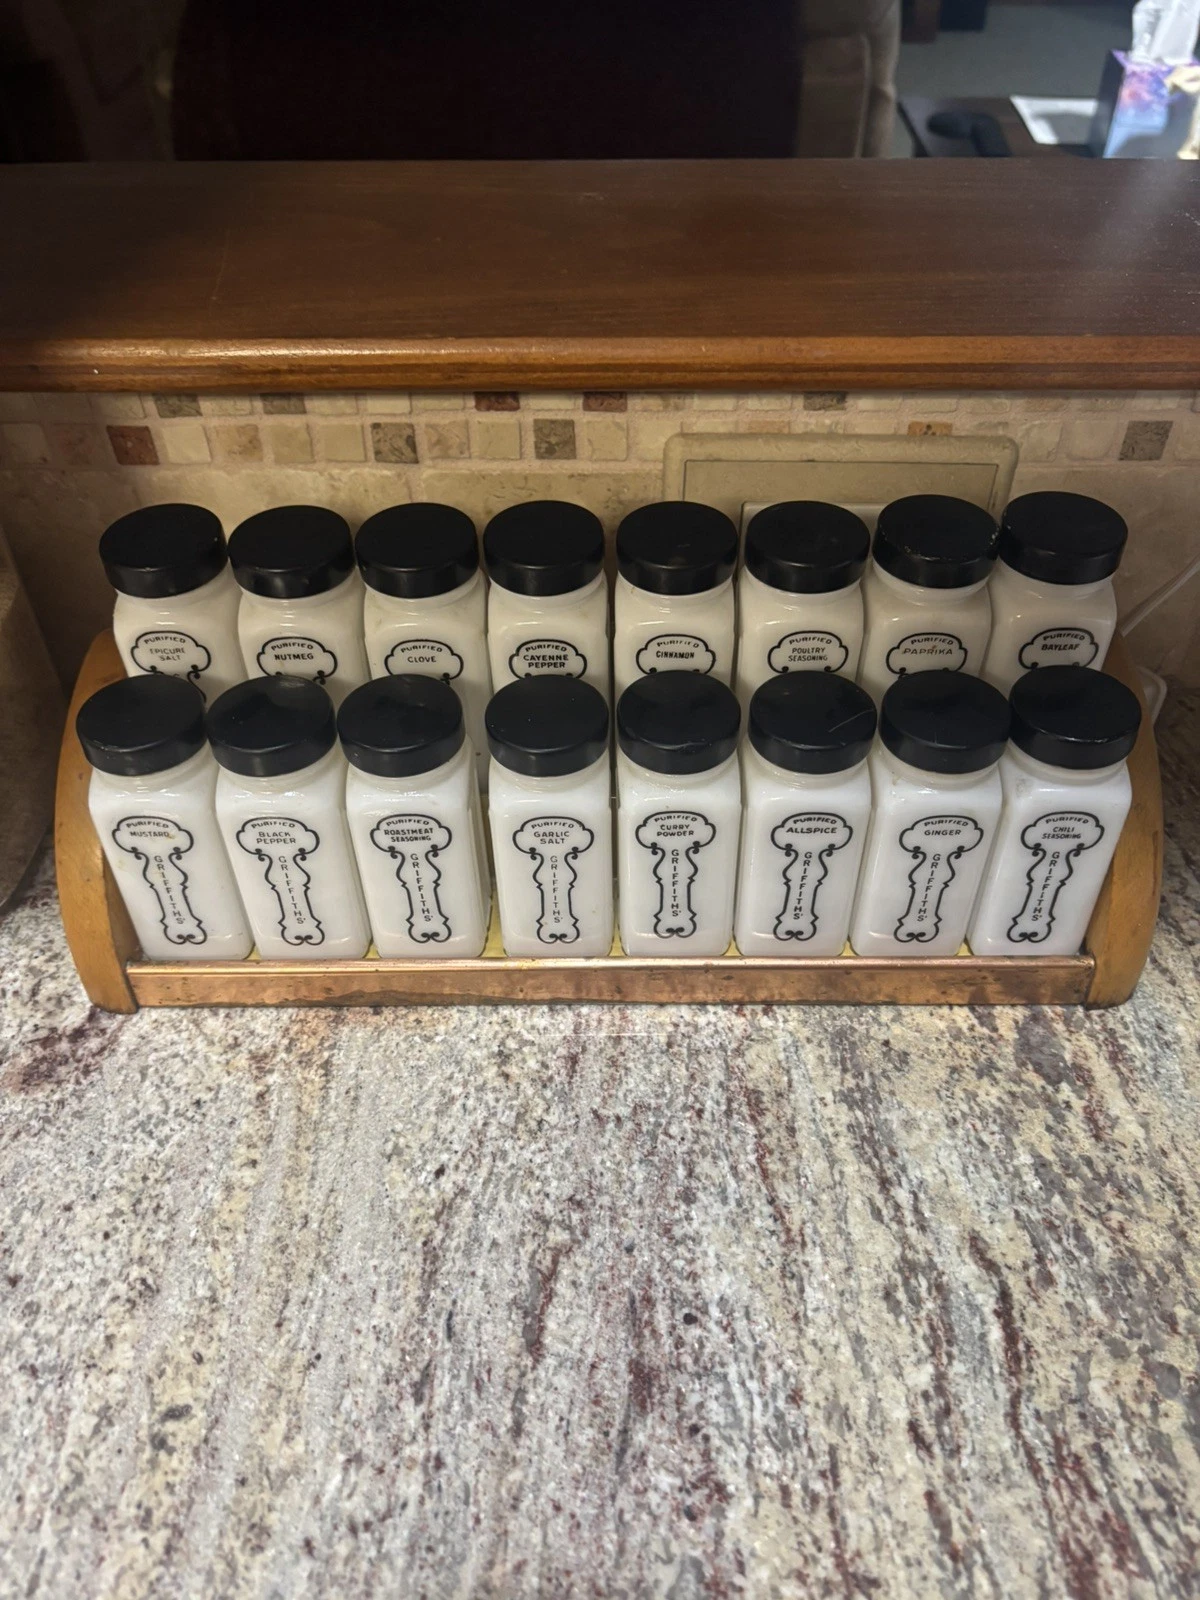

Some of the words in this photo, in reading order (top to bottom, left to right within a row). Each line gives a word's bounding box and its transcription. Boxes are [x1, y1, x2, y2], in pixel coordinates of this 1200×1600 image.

[144, 636, 186, 644] PURIFIED
[789, 637, 832, 645] PURIFIED
[911, 637, 953, 645] PURIFIED
[1043, 633, 1085, 641] PURIFIED
[271, 642, 314, 650] PURIFIED
[525, 644, 567, 652] PURIFIED
[657, 640, 699, 648] PURIFIED
[1041, 643, 1080, 651] BAYLEAF
[400, 645, 443, 653] PURIFIED
[274, 653, 314, 661] NUTMEG
[656, 651, 694, 659] CINNAMON
[654, 815, 697, 823] PURIFIED
[126, 821, 169, 829] PURIFIED
[251, 821, 296, 829] PURIFIED
[531, 821, 574, 829] PURIFIED
